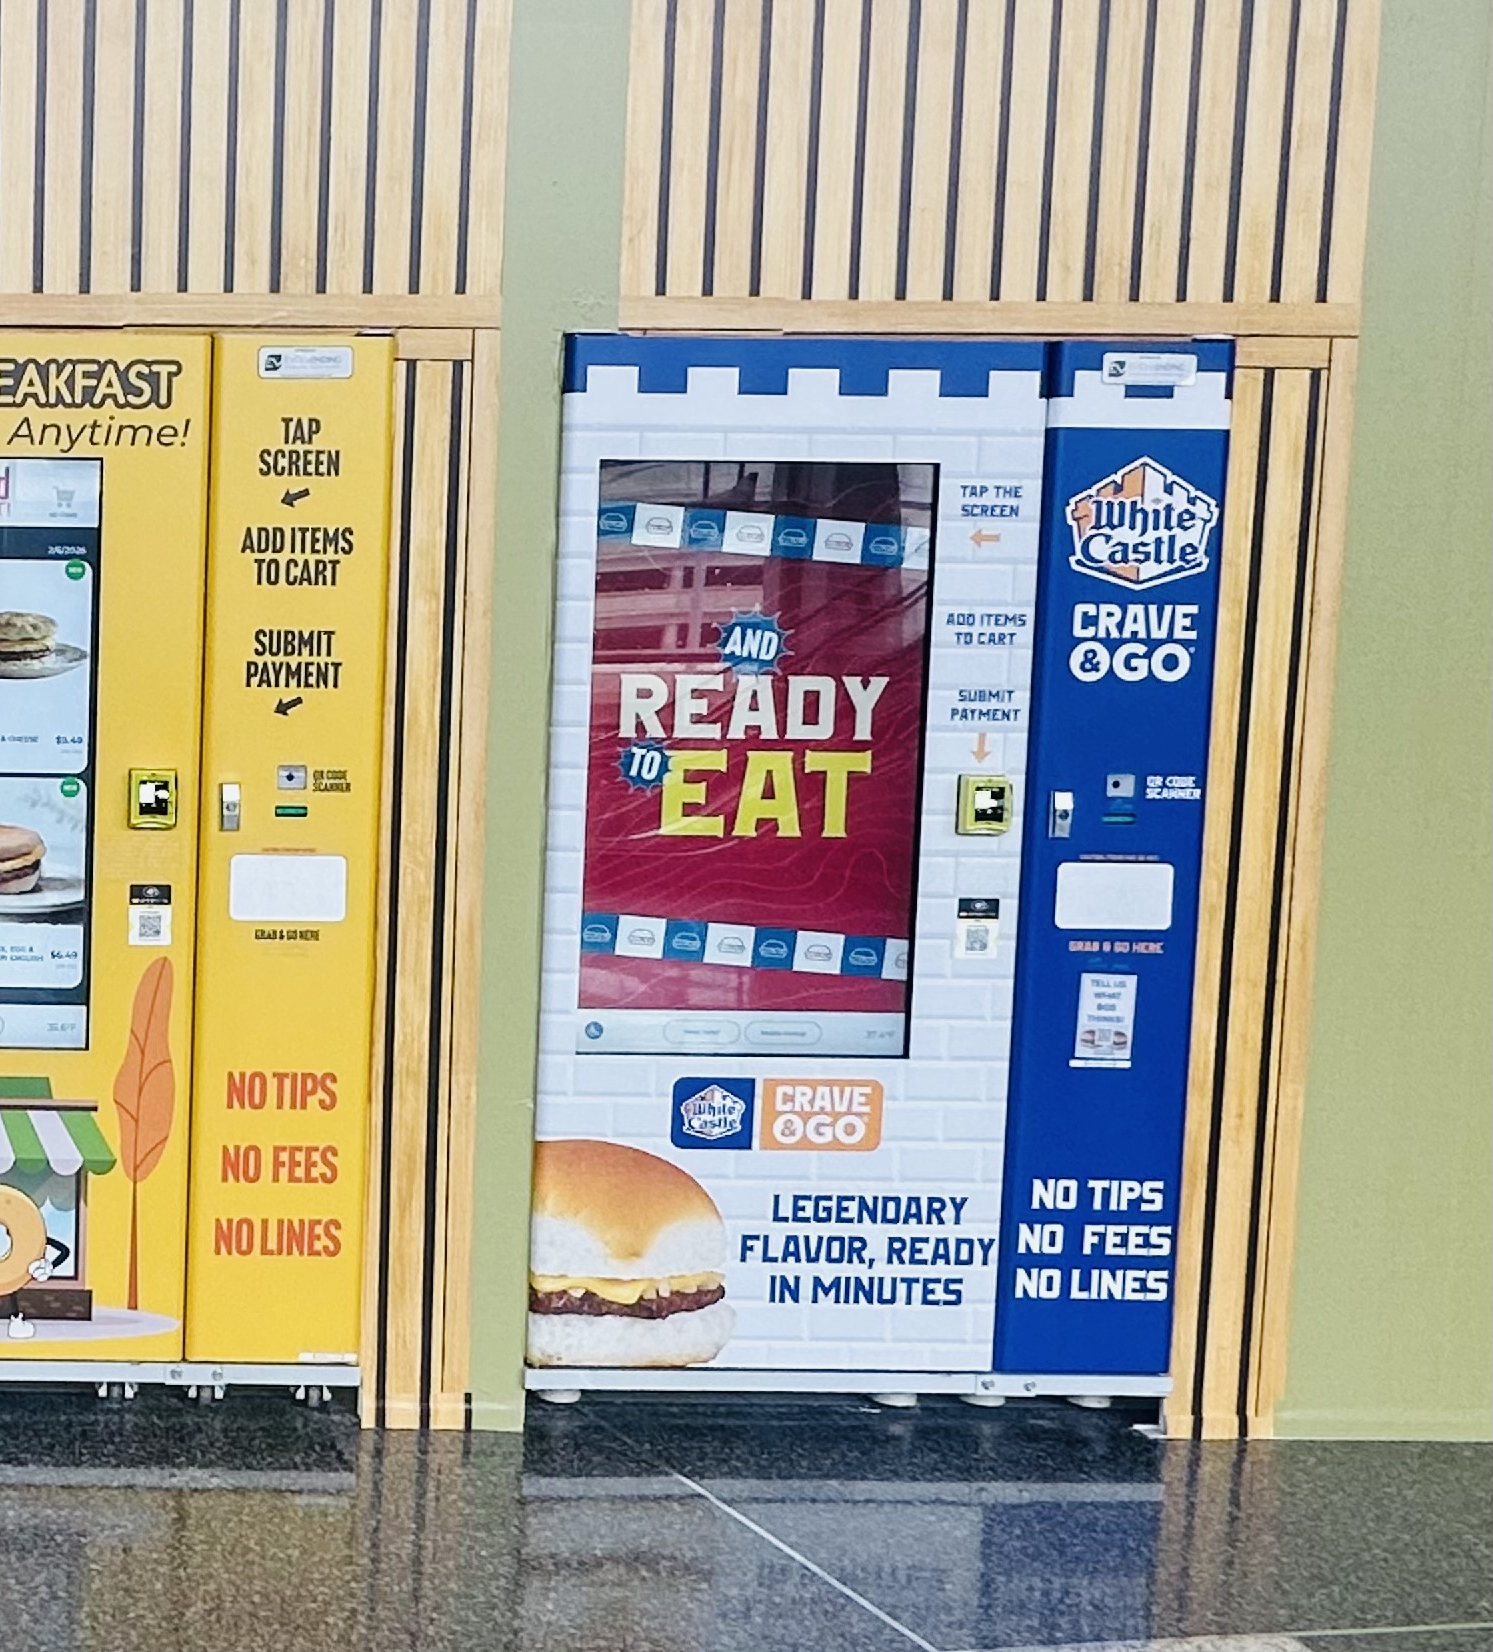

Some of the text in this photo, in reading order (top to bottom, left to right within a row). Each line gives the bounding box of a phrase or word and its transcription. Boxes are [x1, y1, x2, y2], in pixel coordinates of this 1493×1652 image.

[7, 415, 192, 453] Anytime!
[281, 416, 321, 445] TAP
[258, 449, 340, 477] SCREEN
[960, 484, 1023, 499] TAP THE
[960, 503, 1019, 518] SCREEN
[1088, 499, 1197, 538] White
[240, 526, 355, 556] ADD ITEMS
[1080, 532, 1200, 566] Castle
[254, 558, 341, 587] TO CART
[946, 613, 1028, 628] ADD ITEMS
[1073, 602, 1199, 640] CRAVE
[254, 628, 336, 658] SUBMIT
[723, 626, 779, 660] AND
[954, 632, 1017, 647] TO CART
[245, 660, 343, 689] PAYMENT
[618, 673, 890, 741] READY
[958, 689, 1016, 704] SUBMIT
[950, 707, 1022, 722] PAYMENT
[629, 746, 662, 780] TO
[658, 748, 872, 838] EAT
[226, 1071, 339, 1112] NO TIPS
[774, 1085, 872, 1114] CRAVE
[692, 1102, 736, 1118] White
[221, 1144, 339, 1184] NO FEES
[772, 1193, 969, 1226] LEGENDARY
[1031, 1178, 1165, 1212] NO TIPS
[214, 1217, 342, 1258] NO LINES
[739, 1233, 996, 1270] FLAVOR, READY
[1017, 1223, 1172, 1256] NO FEES
[768, 1274, 964, 1306] IN MINUTES
[1014, 1267, 1170, 1302] NO LINES
